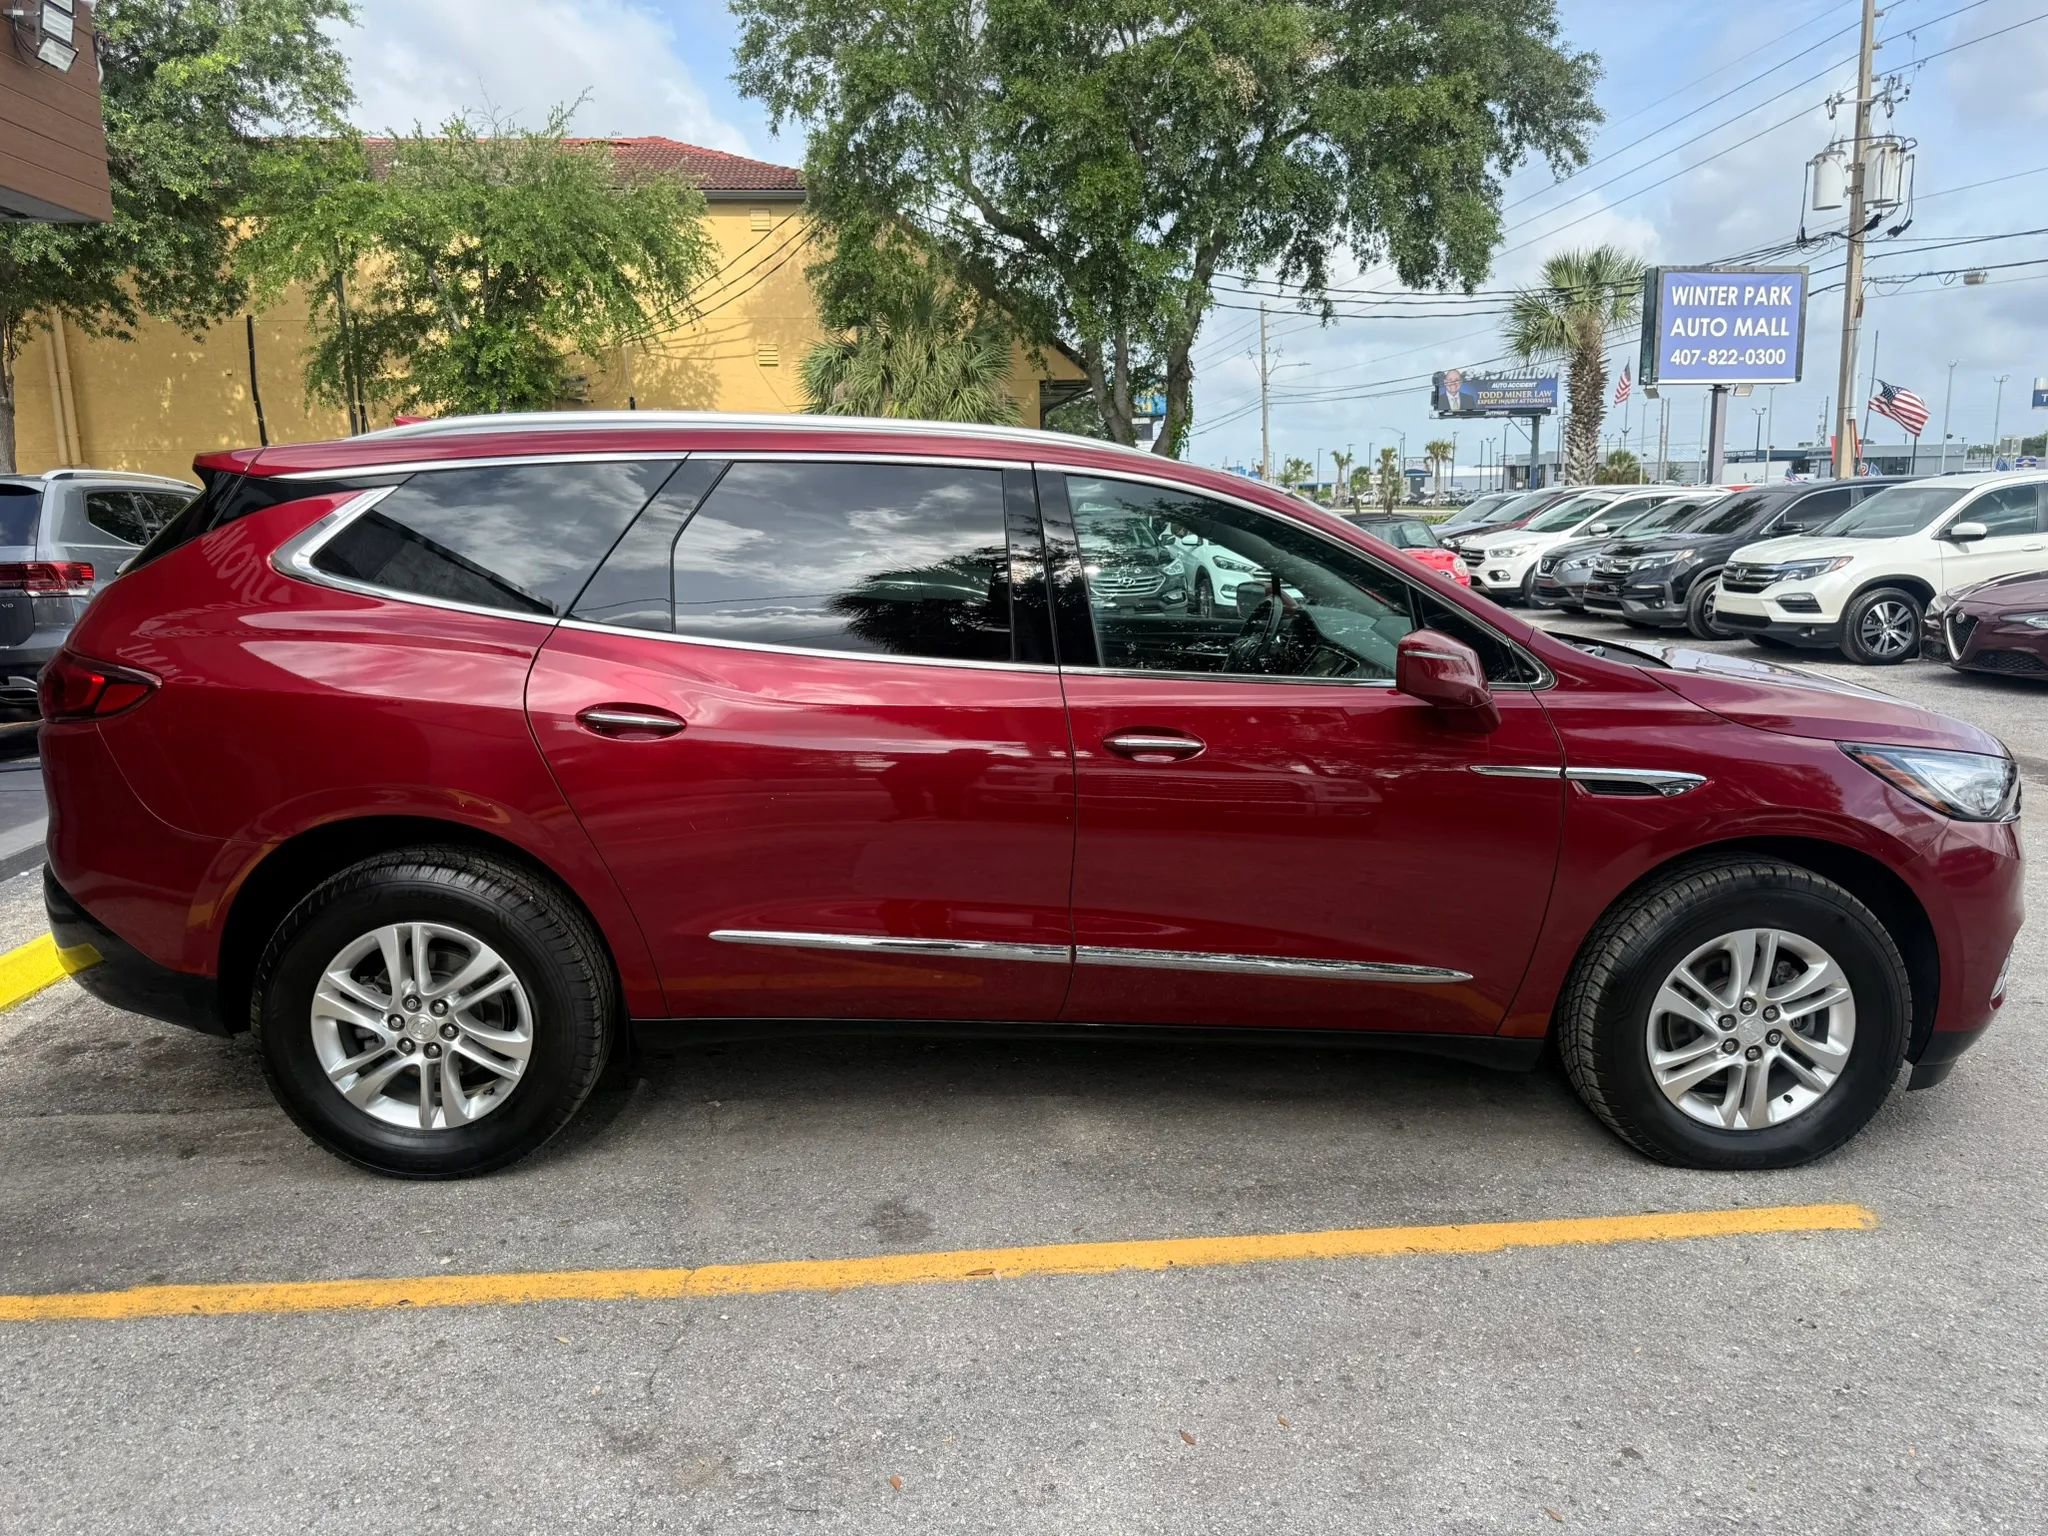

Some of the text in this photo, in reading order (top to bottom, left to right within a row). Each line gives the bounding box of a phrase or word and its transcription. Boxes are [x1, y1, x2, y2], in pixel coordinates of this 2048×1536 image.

[1672, 286, 1793, 306] WINTER PARK
[1670, 317, 1790, 337] AUTO MALL
[1670, 349, 1786, 365] 407-822-0300
[1501, 367, 1557, 380] MILLION
[1478, 390, 1552, 399] TODD MINER LAW
